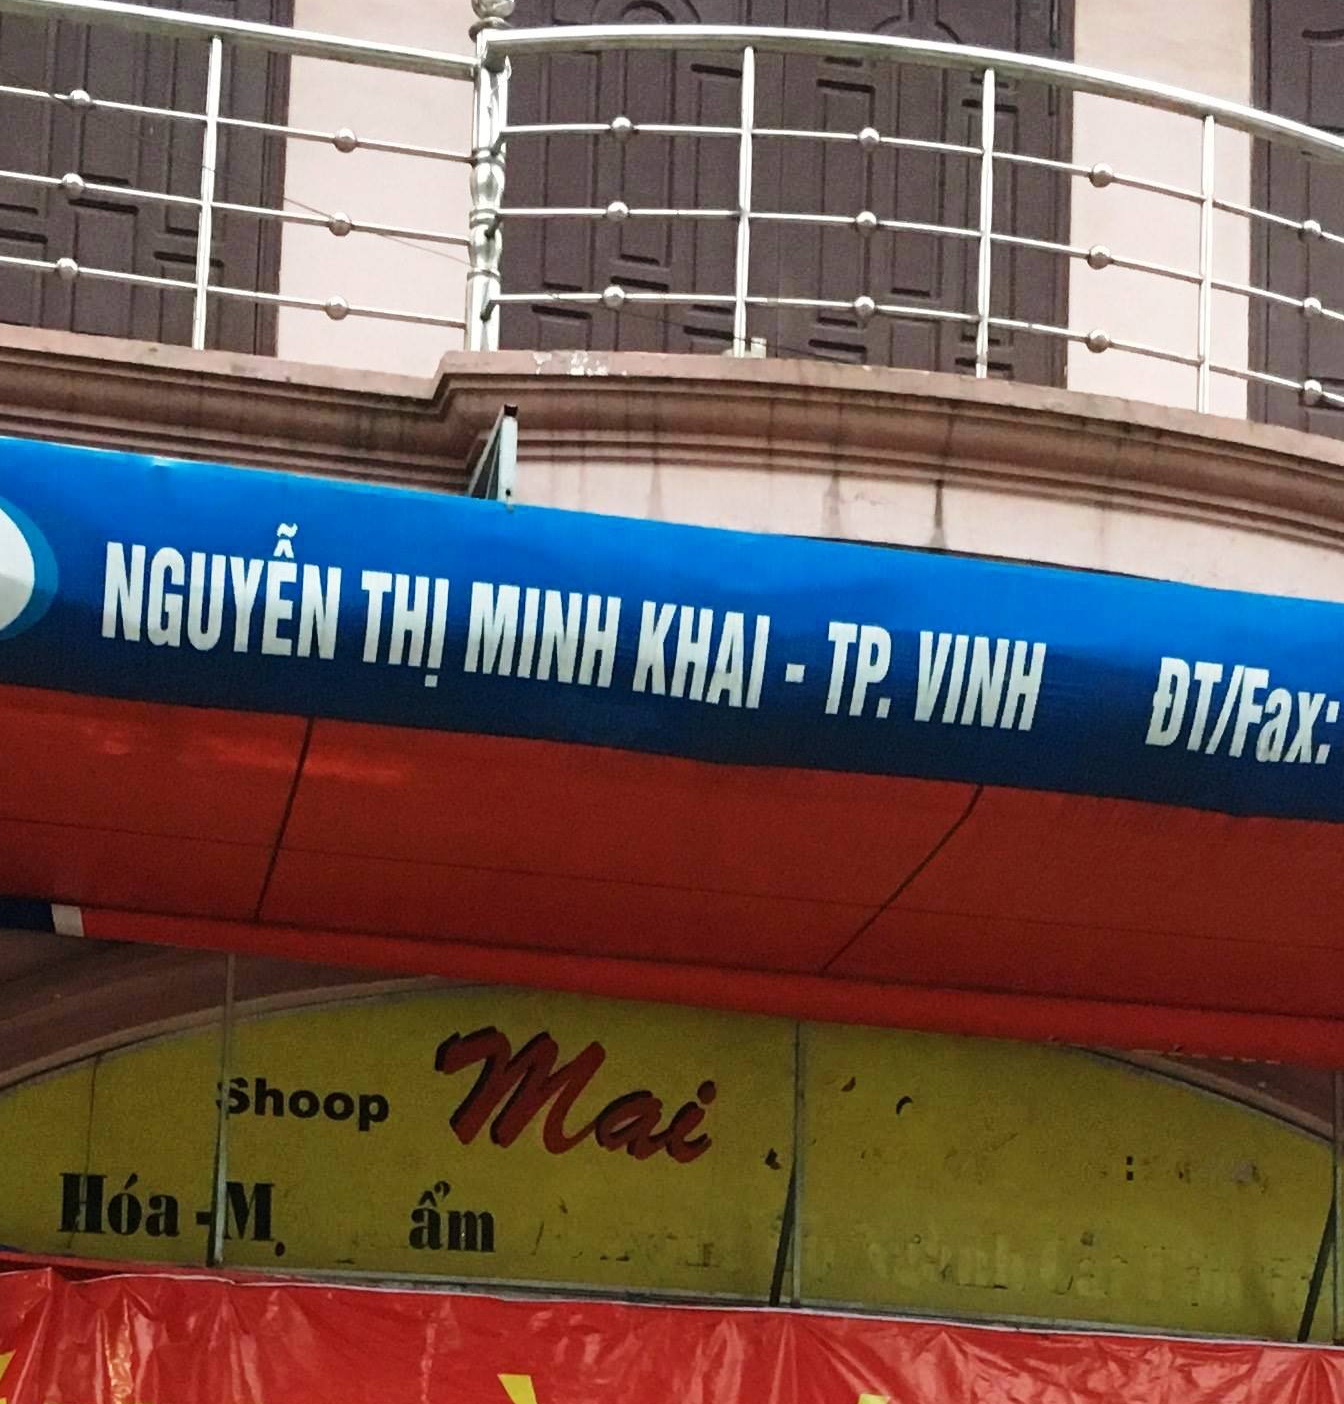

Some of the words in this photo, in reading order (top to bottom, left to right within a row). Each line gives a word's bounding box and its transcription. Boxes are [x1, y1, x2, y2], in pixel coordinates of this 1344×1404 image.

[101, 522, 342, 661] NGUYỄN
[361, 571, 451, 688] THỊ
[464, 581, 622, 688] MINH
[632, 602, 771, 709] KHAI
[825, 622, 893, 719] TP.
[914, 632, 1047, 731] VINH
[1145, 657, 1340, 766] ĐT/Fax:
[215, 1077, 391, 1134] Shoop
[434, 1025, 718, 1166] Mai
[57, 1172, 181, 1238] Hóa
